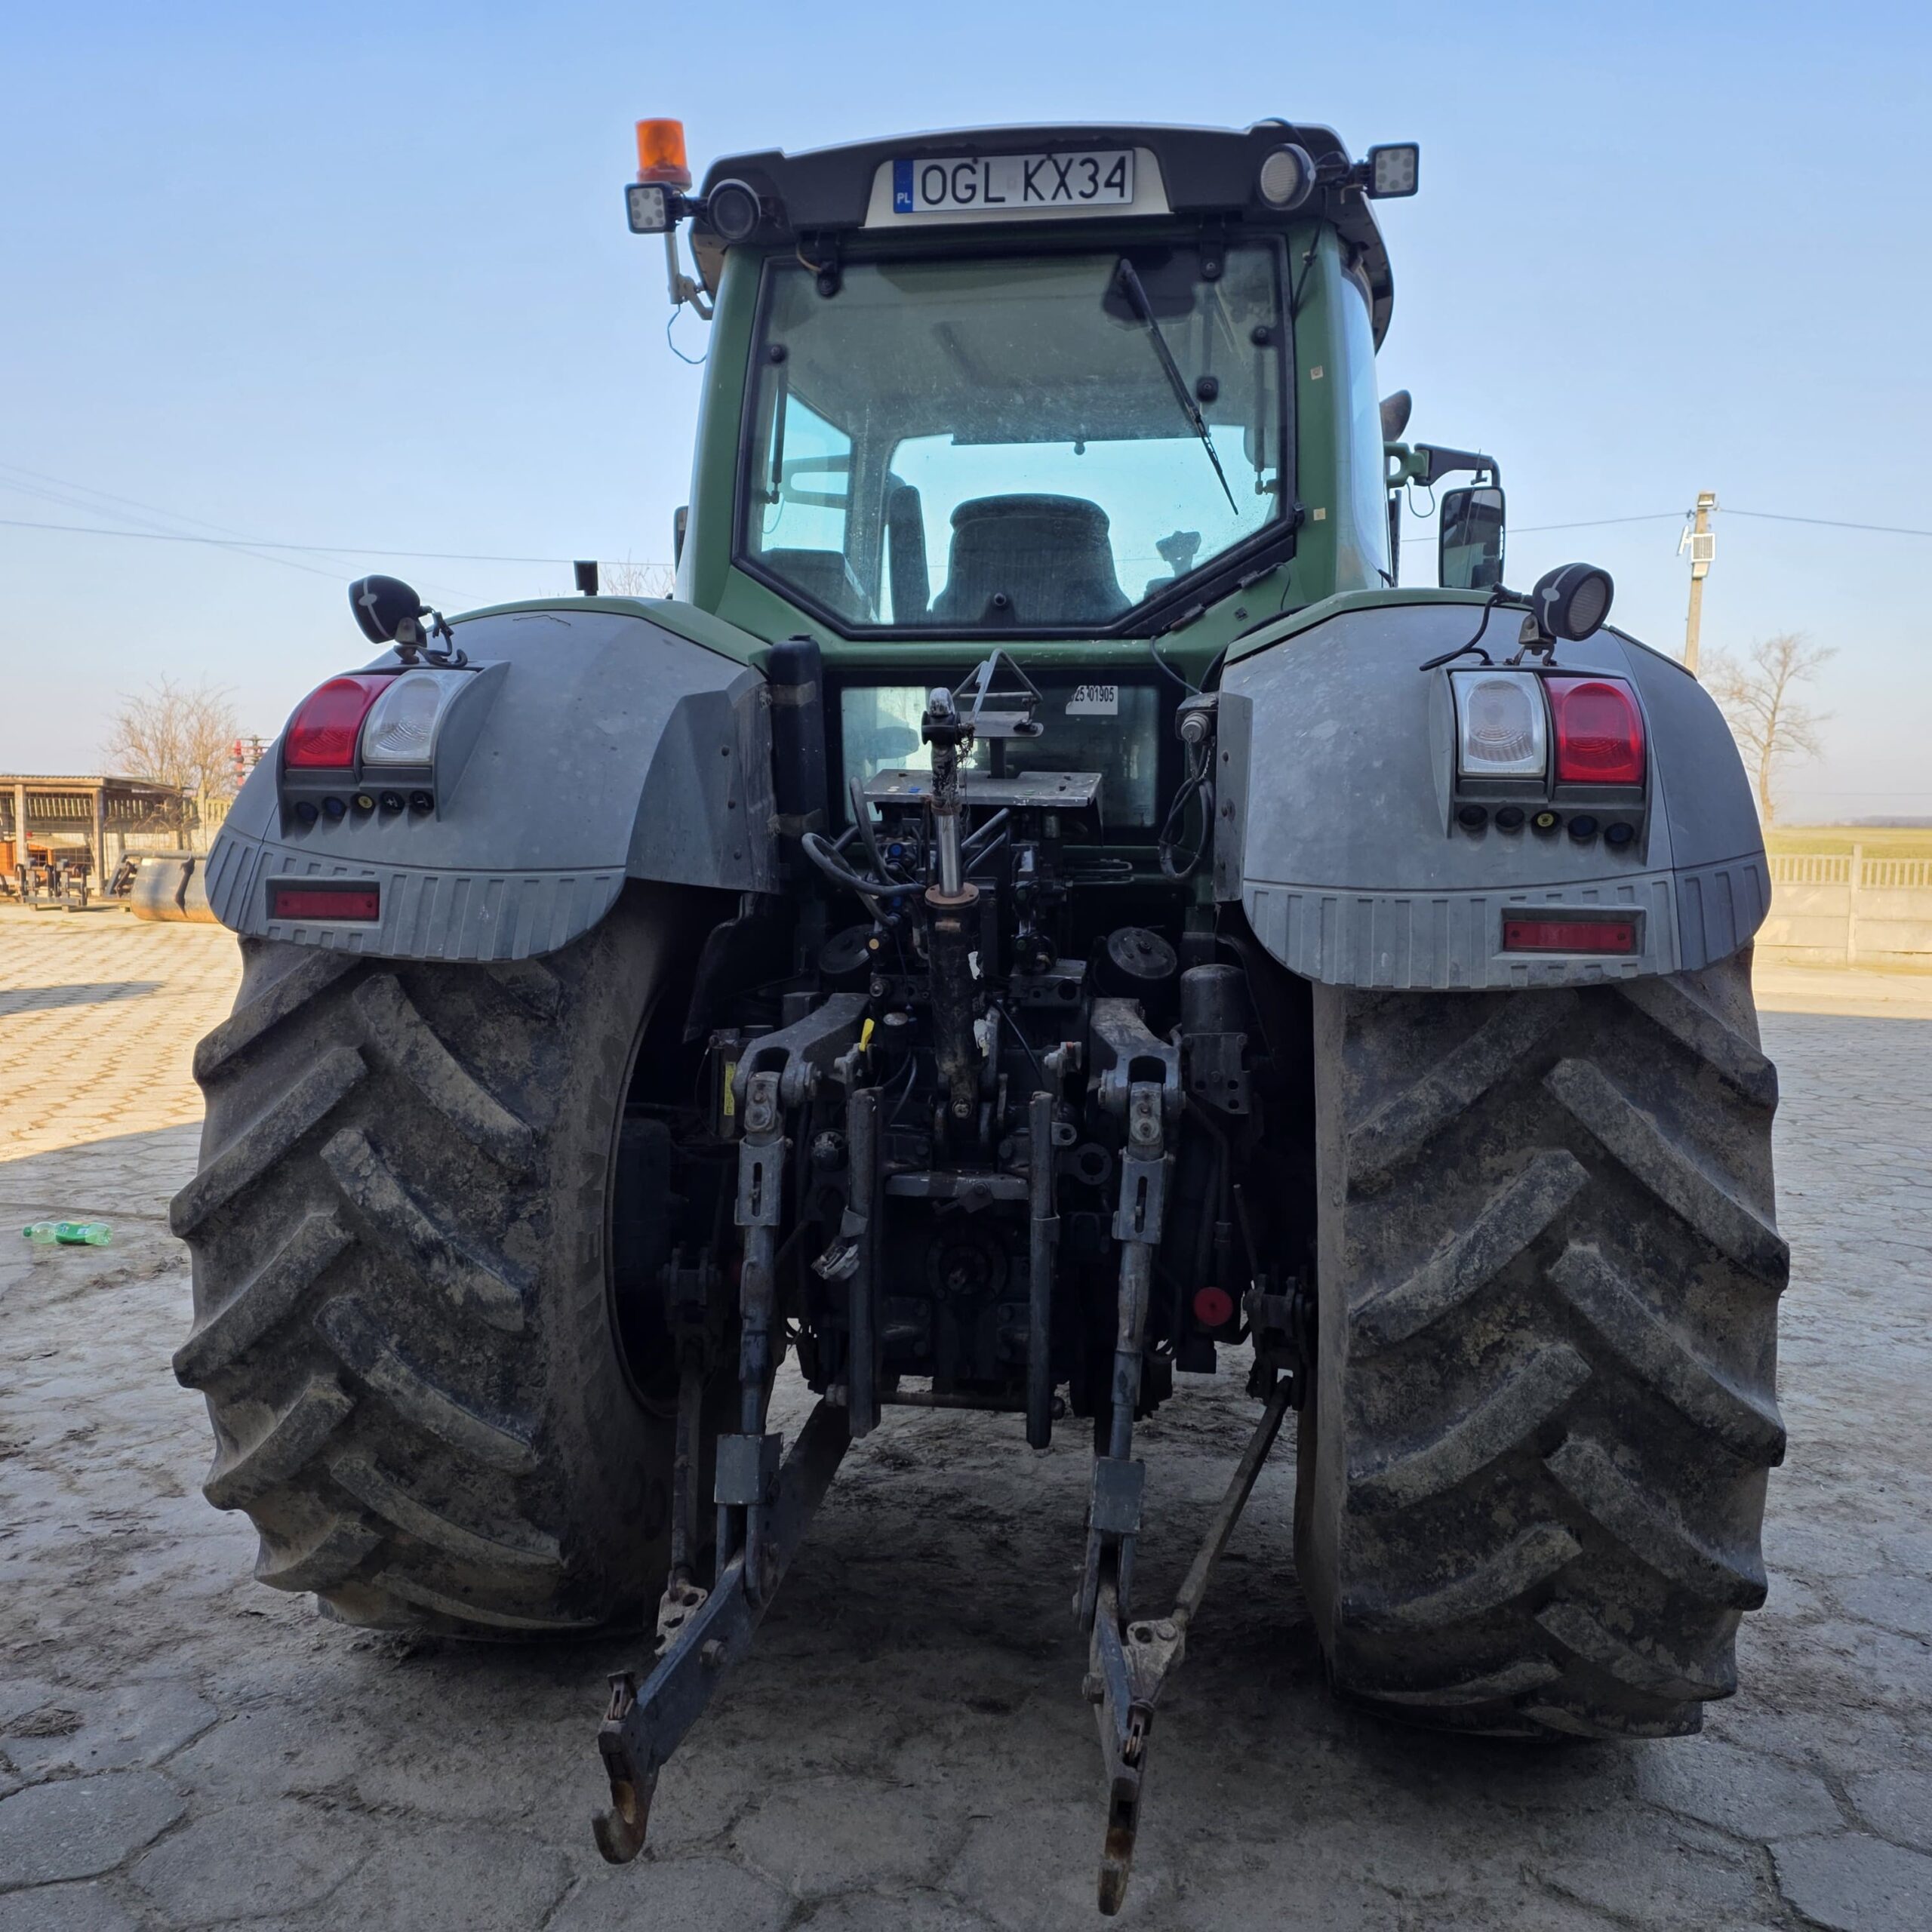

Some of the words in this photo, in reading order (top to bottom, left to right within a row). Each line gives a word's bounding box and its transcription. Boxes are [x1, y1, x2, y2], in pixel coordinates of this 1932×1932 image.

[921, 162, 1005, 205] OGL
[1023, 155, 1127, 202] KX34
[897, 192, 911, 204] PL
